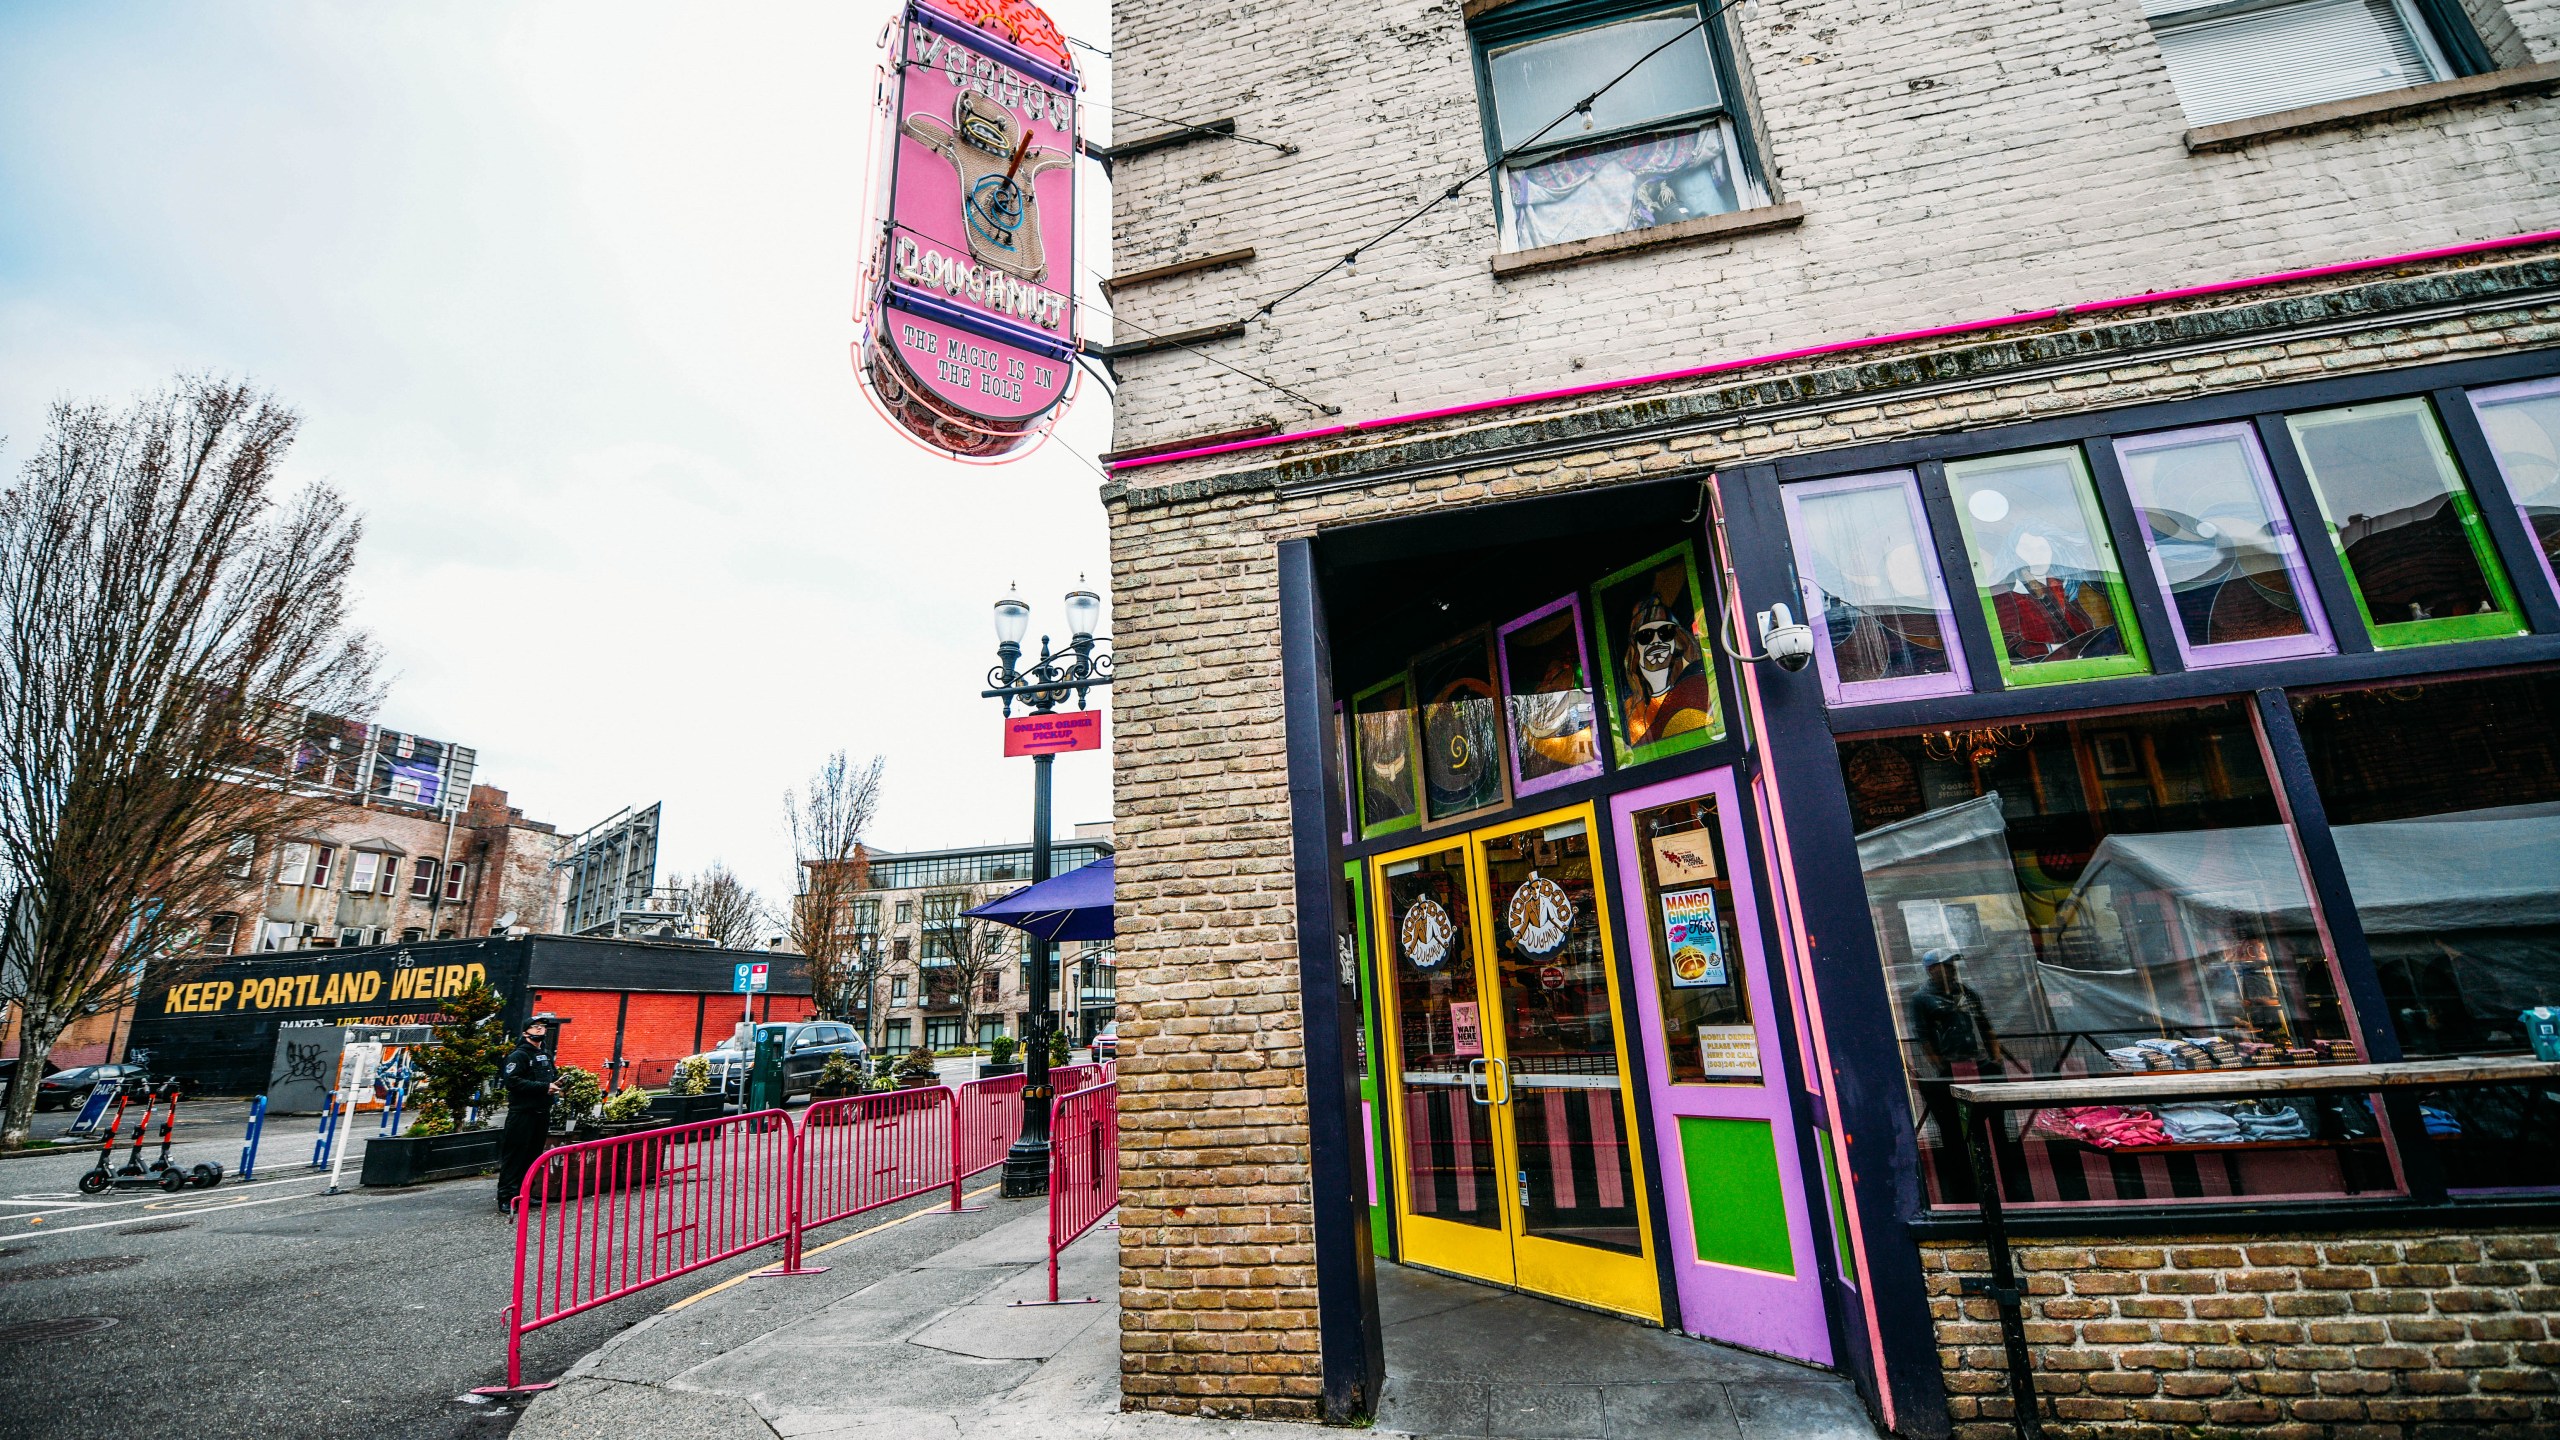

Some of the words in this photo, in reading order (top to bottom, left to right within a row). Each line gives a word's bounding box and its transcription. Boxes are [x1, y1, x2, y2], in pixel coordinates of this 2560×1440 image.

[912, 23, 1070, 132] VOODOO
[895, 236, 1067, 331] DOUGHNUT
[904, 325, 937, 354] THE
[948, 339, 998, 372] MAGIC
[1007, 358, 1024, 380] IS
[1034, 366, 1052, 388] IN
[938, 360, 971, 388] THE
[981, 373, 1021, 402] HOLE
[1013, 721, 1053, 733] ONLINE
[1055, 718, 1092, 729] ORDER
[1032, 729, 1073, 740] PICKUP
[1510, 879, 1571, 929] VOODOO
[1665, 892, 1710, 911] MANGO
[1403, 900, 1451, 944] VOODOO
[1668, 907, 1712, 925] GINGER
[1688, 918, 1716, 935] Kiss
[163, 980, 235, 1013] KEEP
[237, 970, 381, 1010] PORTLAND
[389, 963, 486, 1001] WEIRD
[739, 977, 747, 988] 2
[336, 1017, 362, 1028] LIVE
[400, 1014, 418, 1025] ON
[1457, 1025, 1476, 1033] WAIT
[1457, 1032, 1477, 1040] HERE
[1701, 1033, 1726, 1041] MOBILE
